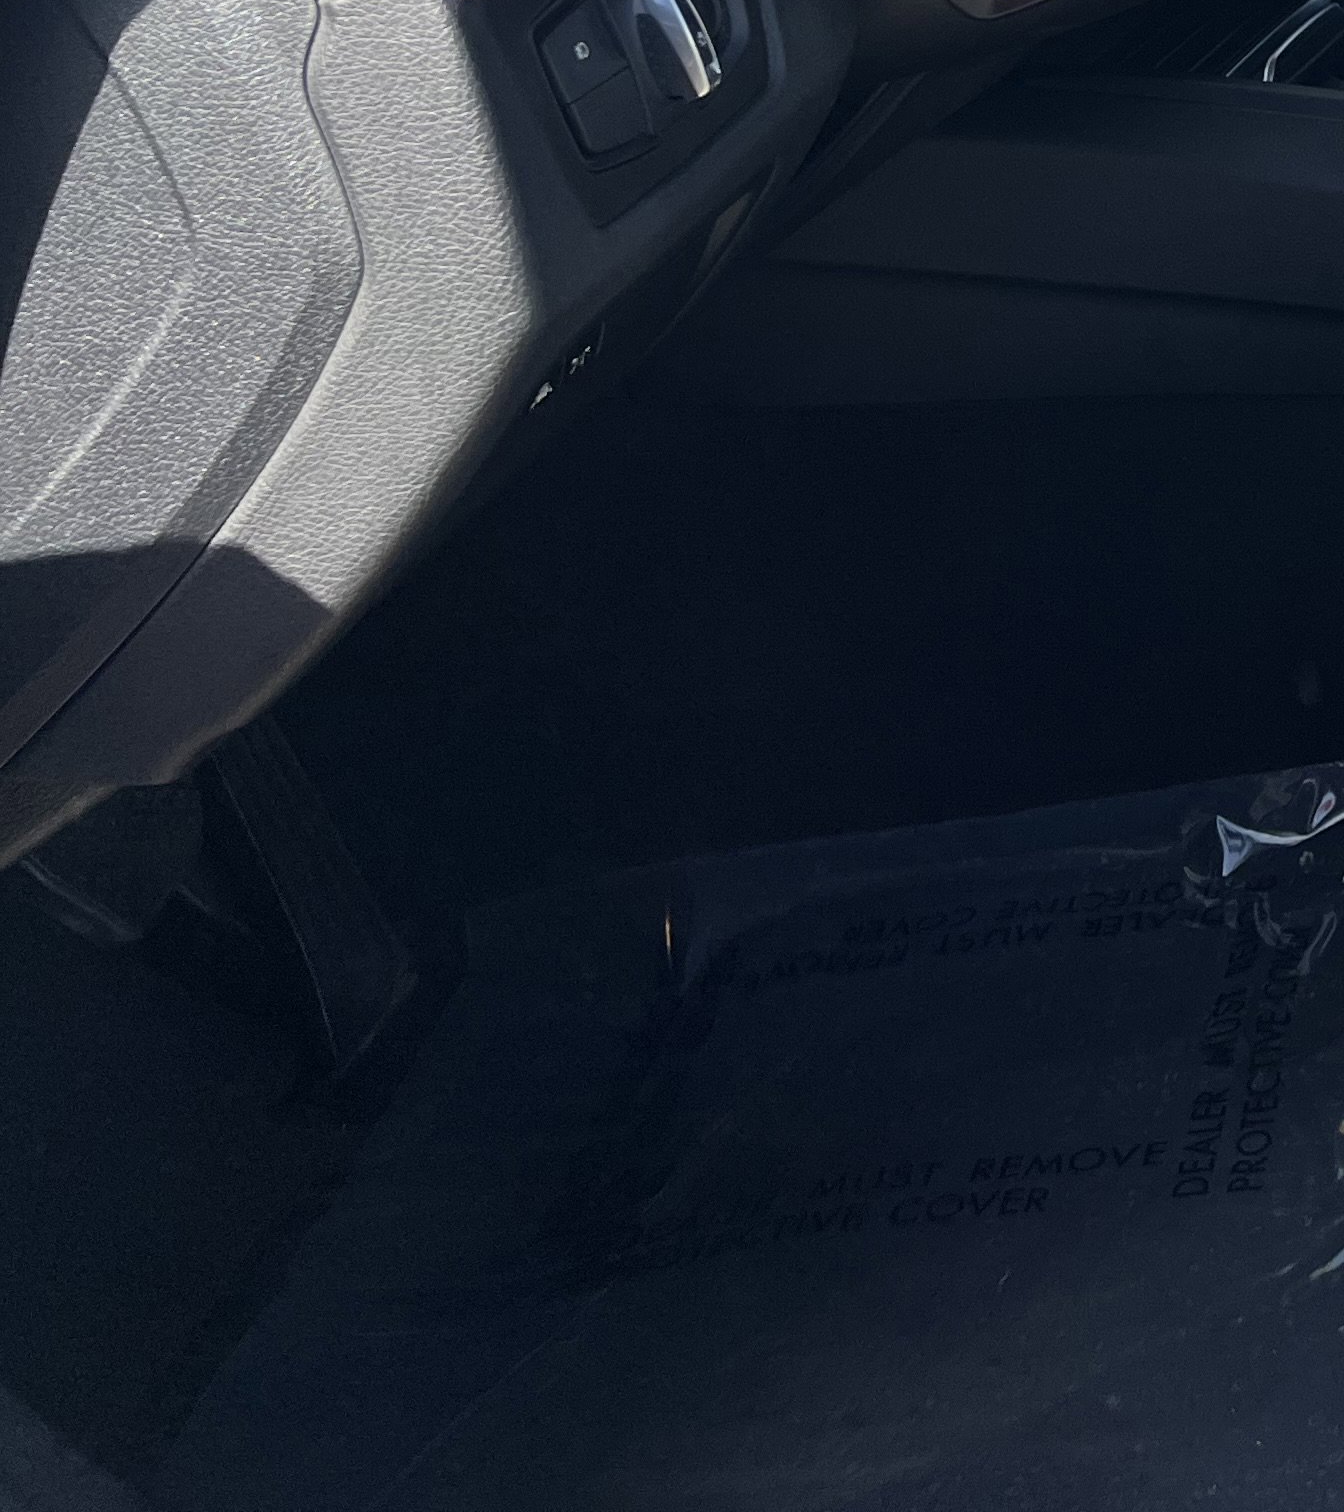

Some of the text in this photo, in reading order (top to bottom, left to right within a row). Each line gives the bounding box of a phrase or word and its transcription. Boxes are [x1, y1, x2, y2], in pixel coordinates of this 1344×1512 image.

[969, 1140, 1169, 1183] REMOVE
[1171, 1087, 1231, 1199] DEALER
[891, 1186, 1051, 1227] COVER
